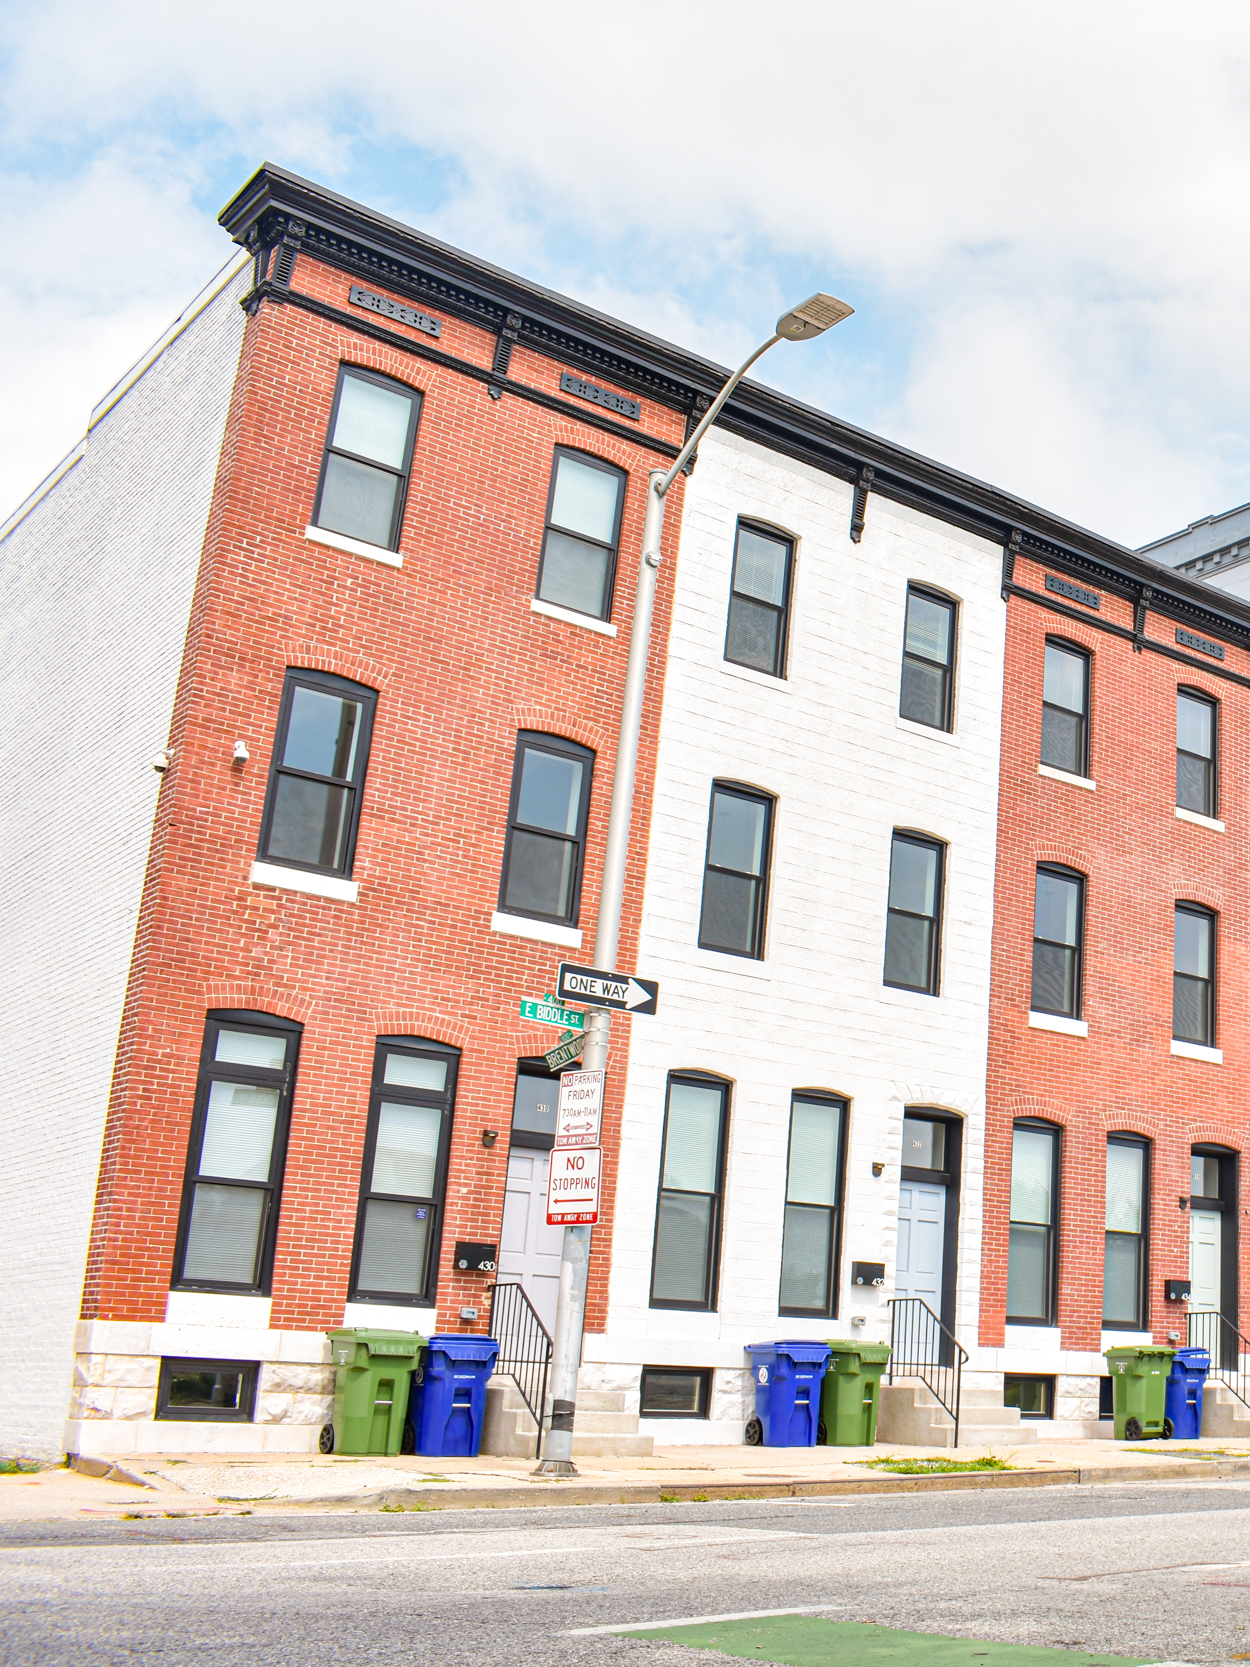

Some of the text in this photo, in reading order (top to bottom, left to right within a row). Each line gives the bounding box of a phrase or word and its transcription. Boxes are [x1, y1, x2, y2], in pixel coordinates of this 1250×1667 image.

[569, 976, 629, 999] ONE WAY
[536, 1006, 570, 1025] BIDDLE
[562, 1073, 601, 1086] NO PARKING
[567, 1088, 596, 1101] FRIDAY
[557, 1134, 597, 1145] TOW AWAY ZONE
[566, 1156, 585, 1170] NO
[552, 1177, 596, 1191] STOPPING
[551, 1213, 593, 1222] TOW AWAY ZONE
[478, 1260, 496, 1271] 430
